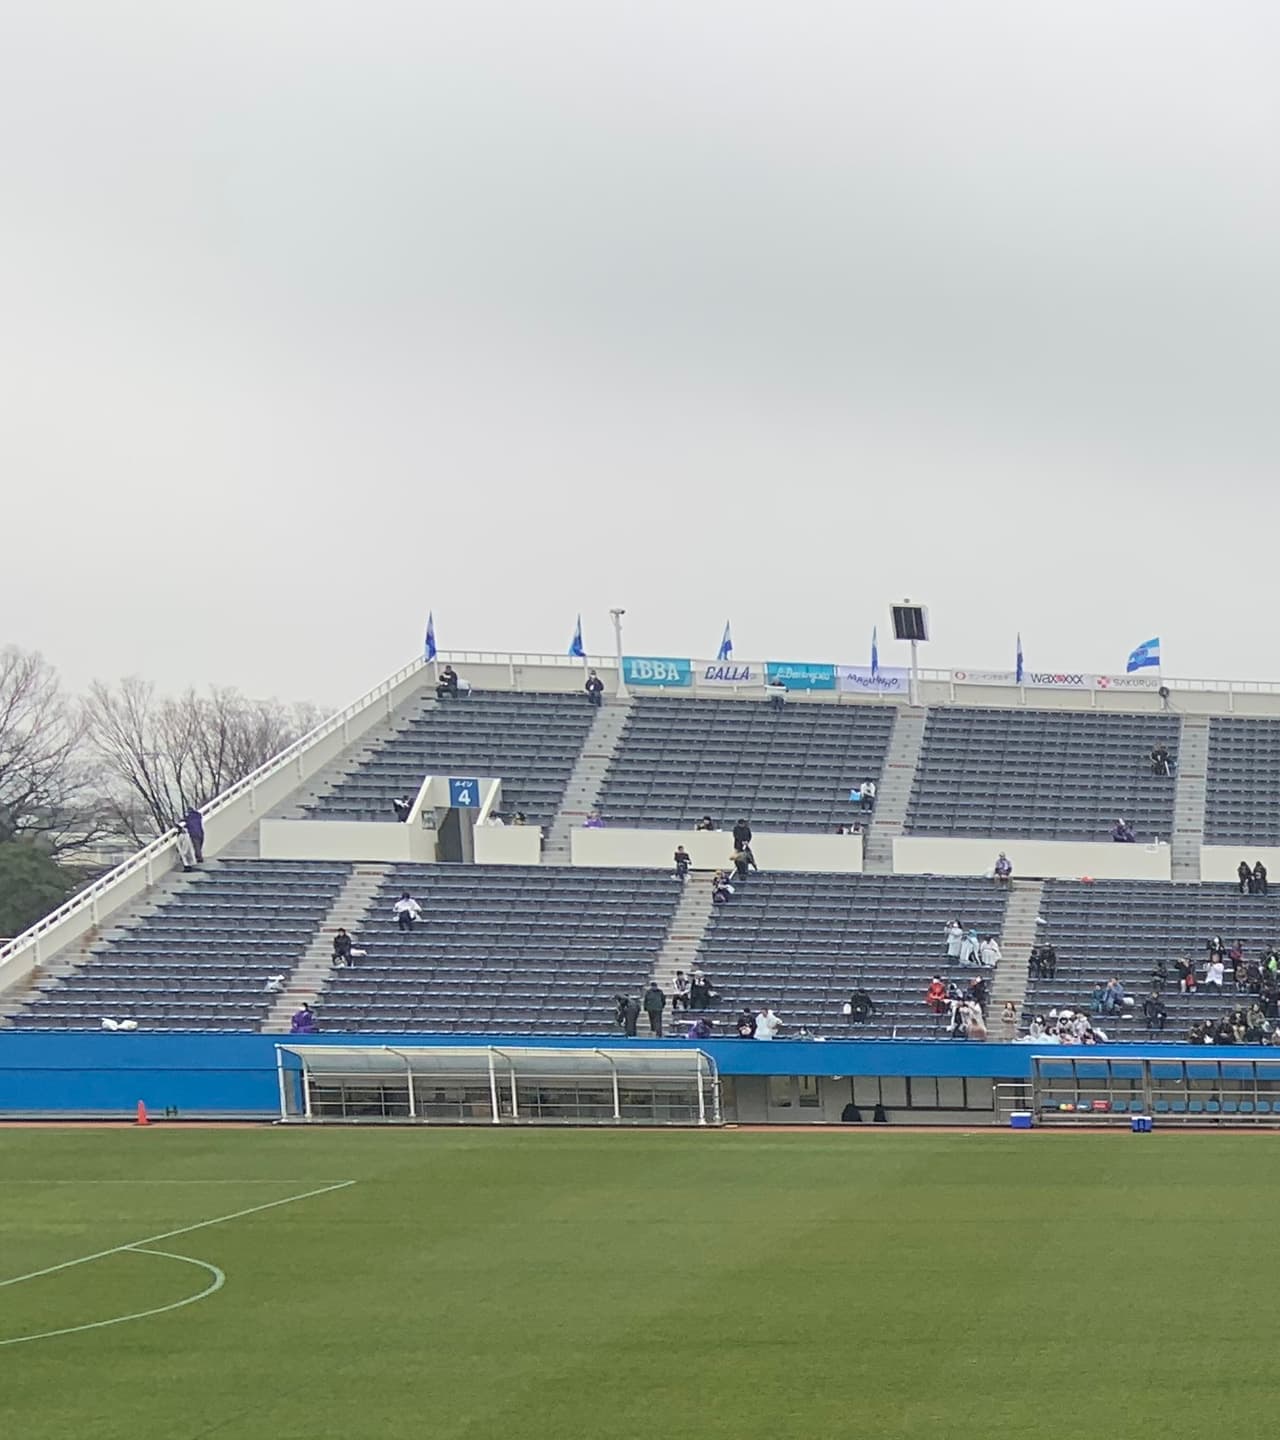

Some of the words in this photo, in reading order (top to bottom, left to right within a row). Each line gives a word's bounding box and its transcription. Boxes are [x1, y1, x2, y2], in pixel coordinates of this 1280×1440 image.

[630, 660, 680, 681] IBBA
[704, 666, 750, 681] CALLA
[458, 789, 471, 805] 4
